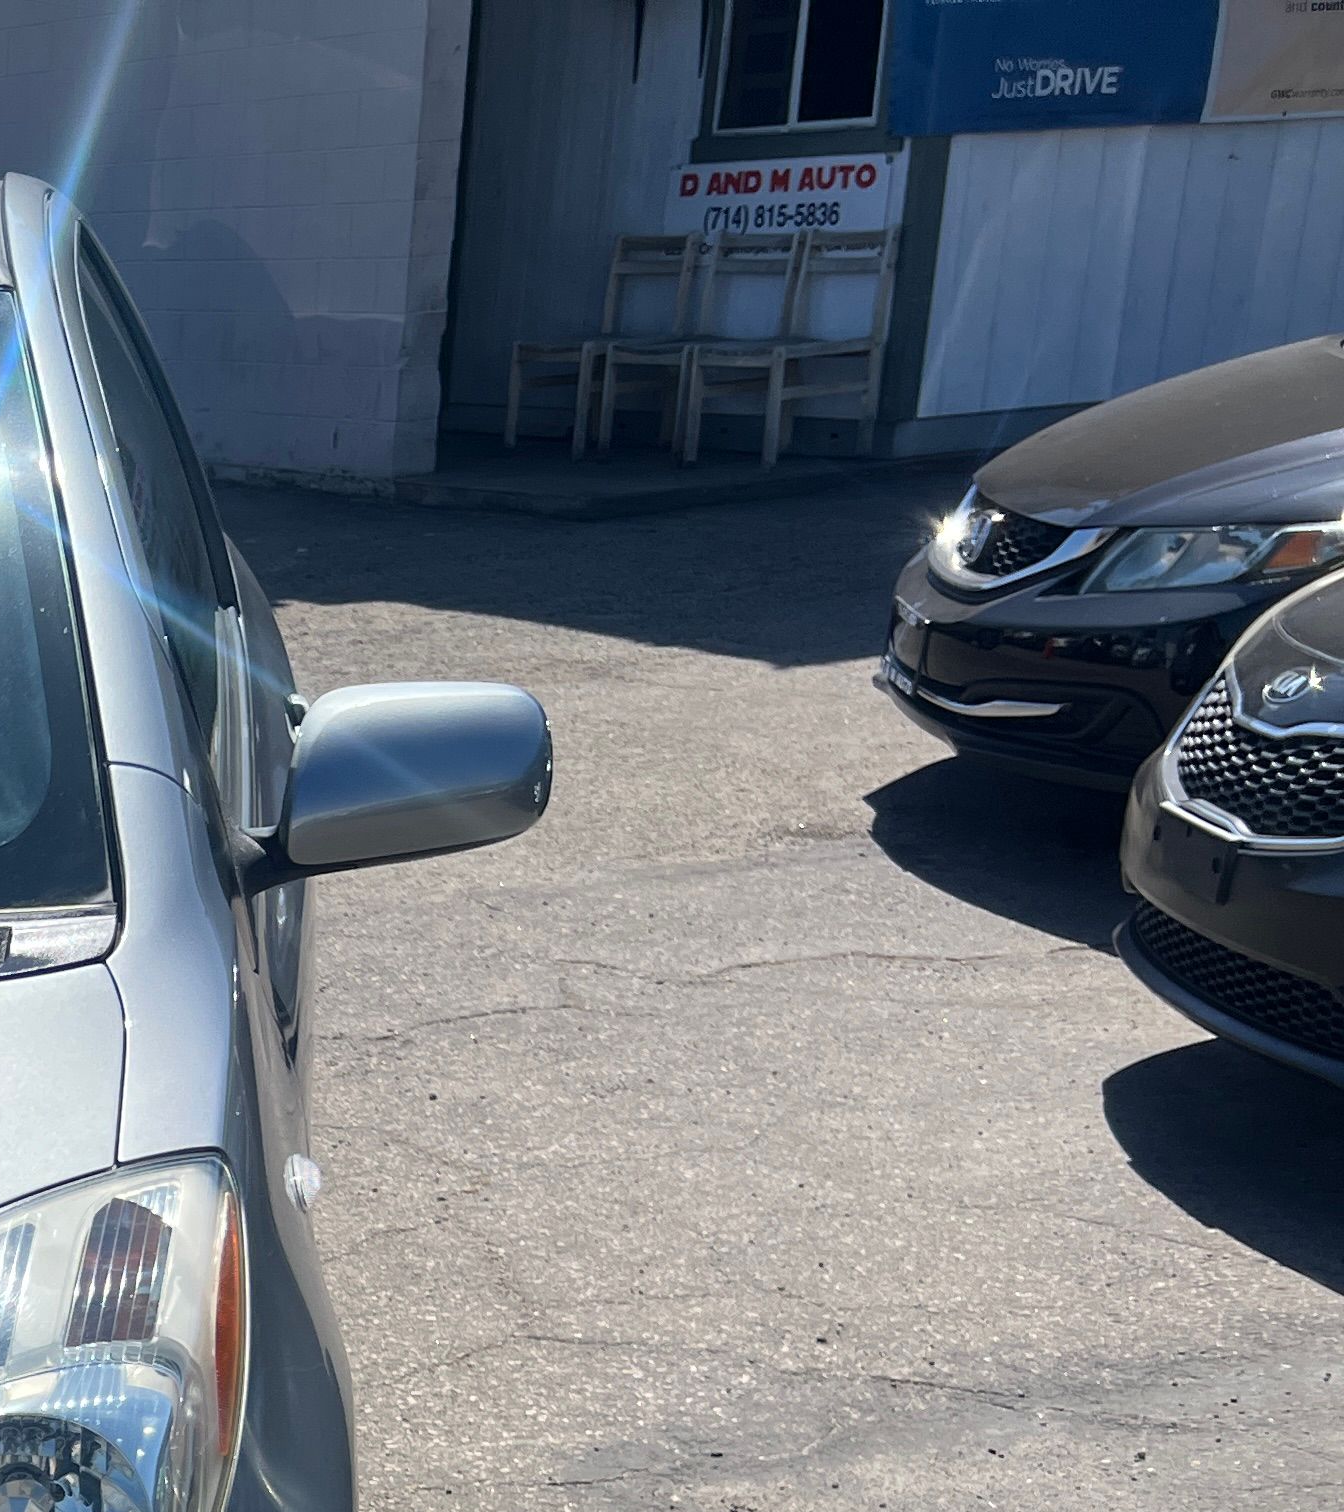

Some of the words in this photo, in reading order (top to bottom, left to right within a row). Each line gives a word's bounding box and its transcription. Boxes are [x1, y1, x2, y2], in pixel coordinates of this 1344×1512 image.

[993, 58, 1015, 73] No
[680, 173, 700, 197] D
[706, 170, 763, 195] AND
[769, 168, 792, 193] M
[797, 163, 877, 192] AUTO
[703, 203, 749, 236] (714)
[753, 201, 841, 229] 815-5836
